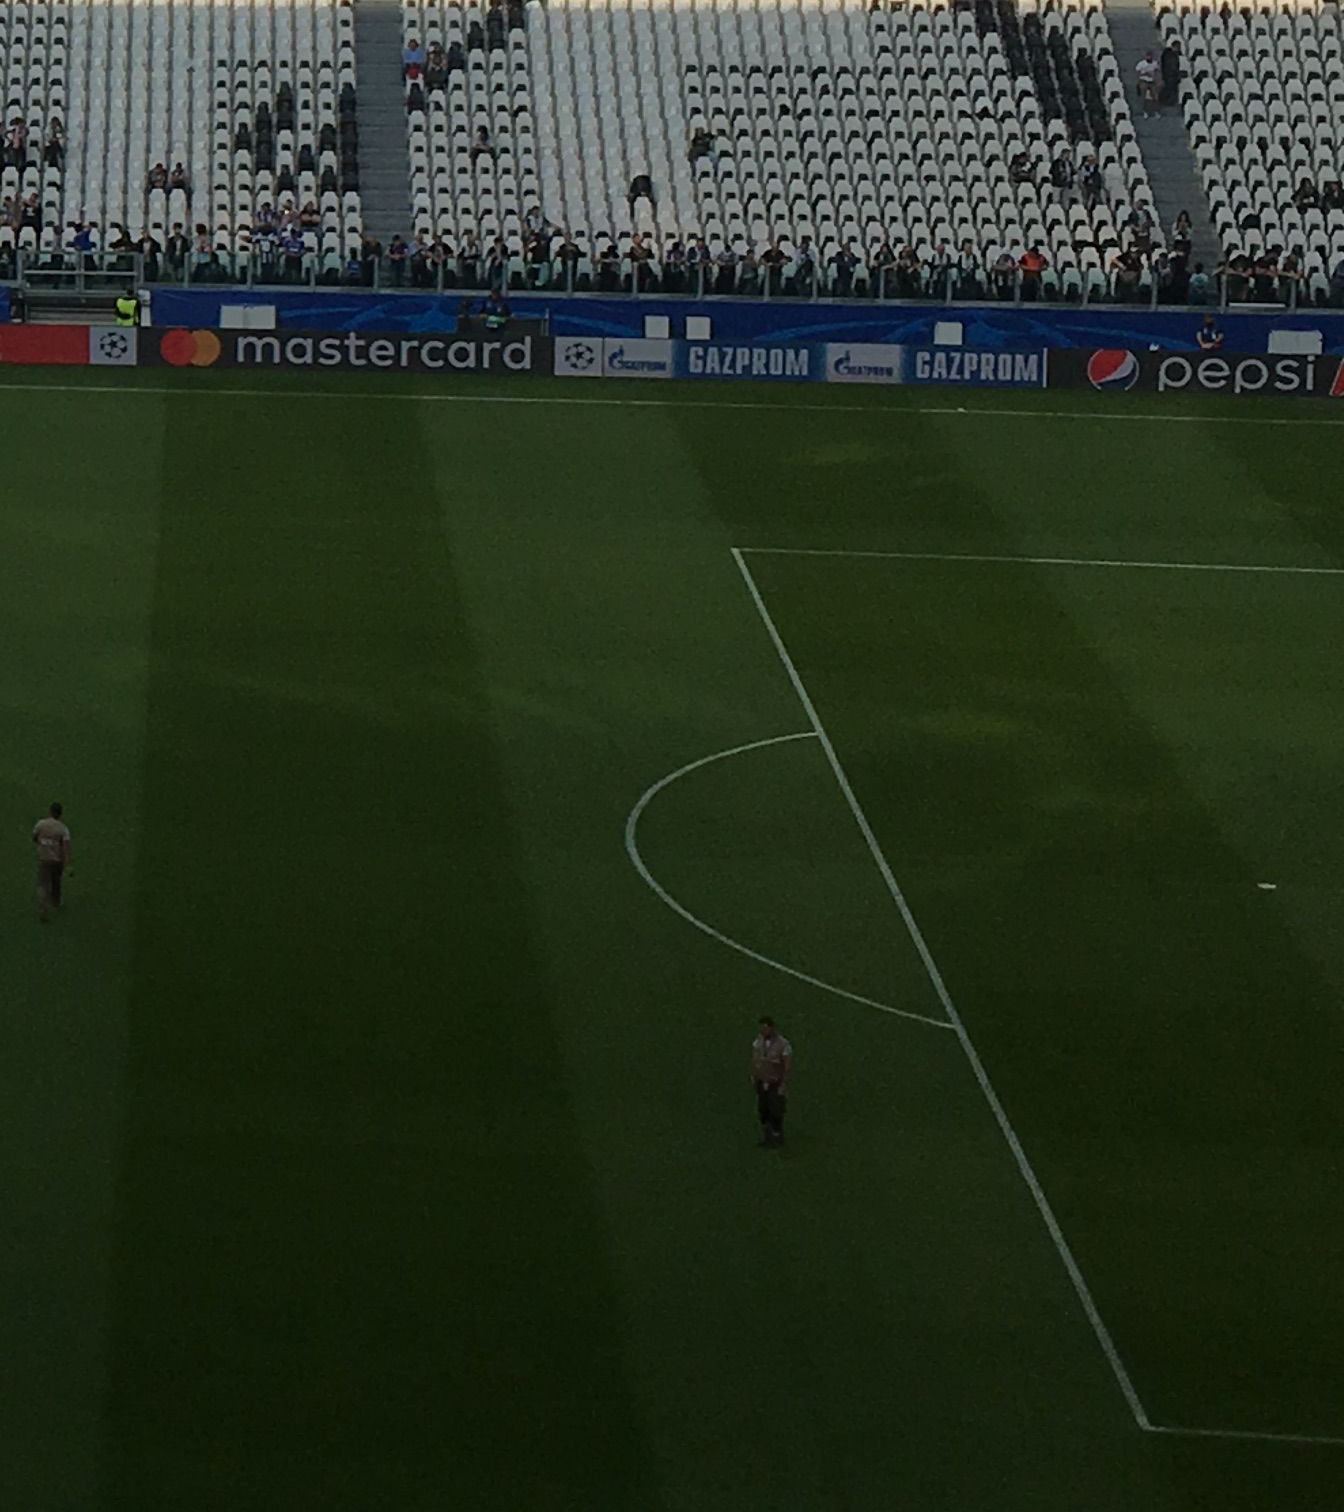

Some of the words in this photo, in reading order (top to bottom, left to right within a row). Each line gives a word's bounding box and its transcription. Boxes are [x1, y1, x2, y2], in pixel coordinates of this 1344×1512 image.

[236, 331, 532, 370] mastercard
[689, 346, 809, 375] GAZPROM
[916, 351, 1038, 382] GAZPROM
[1158, 355, 1315, 393] pepsi
